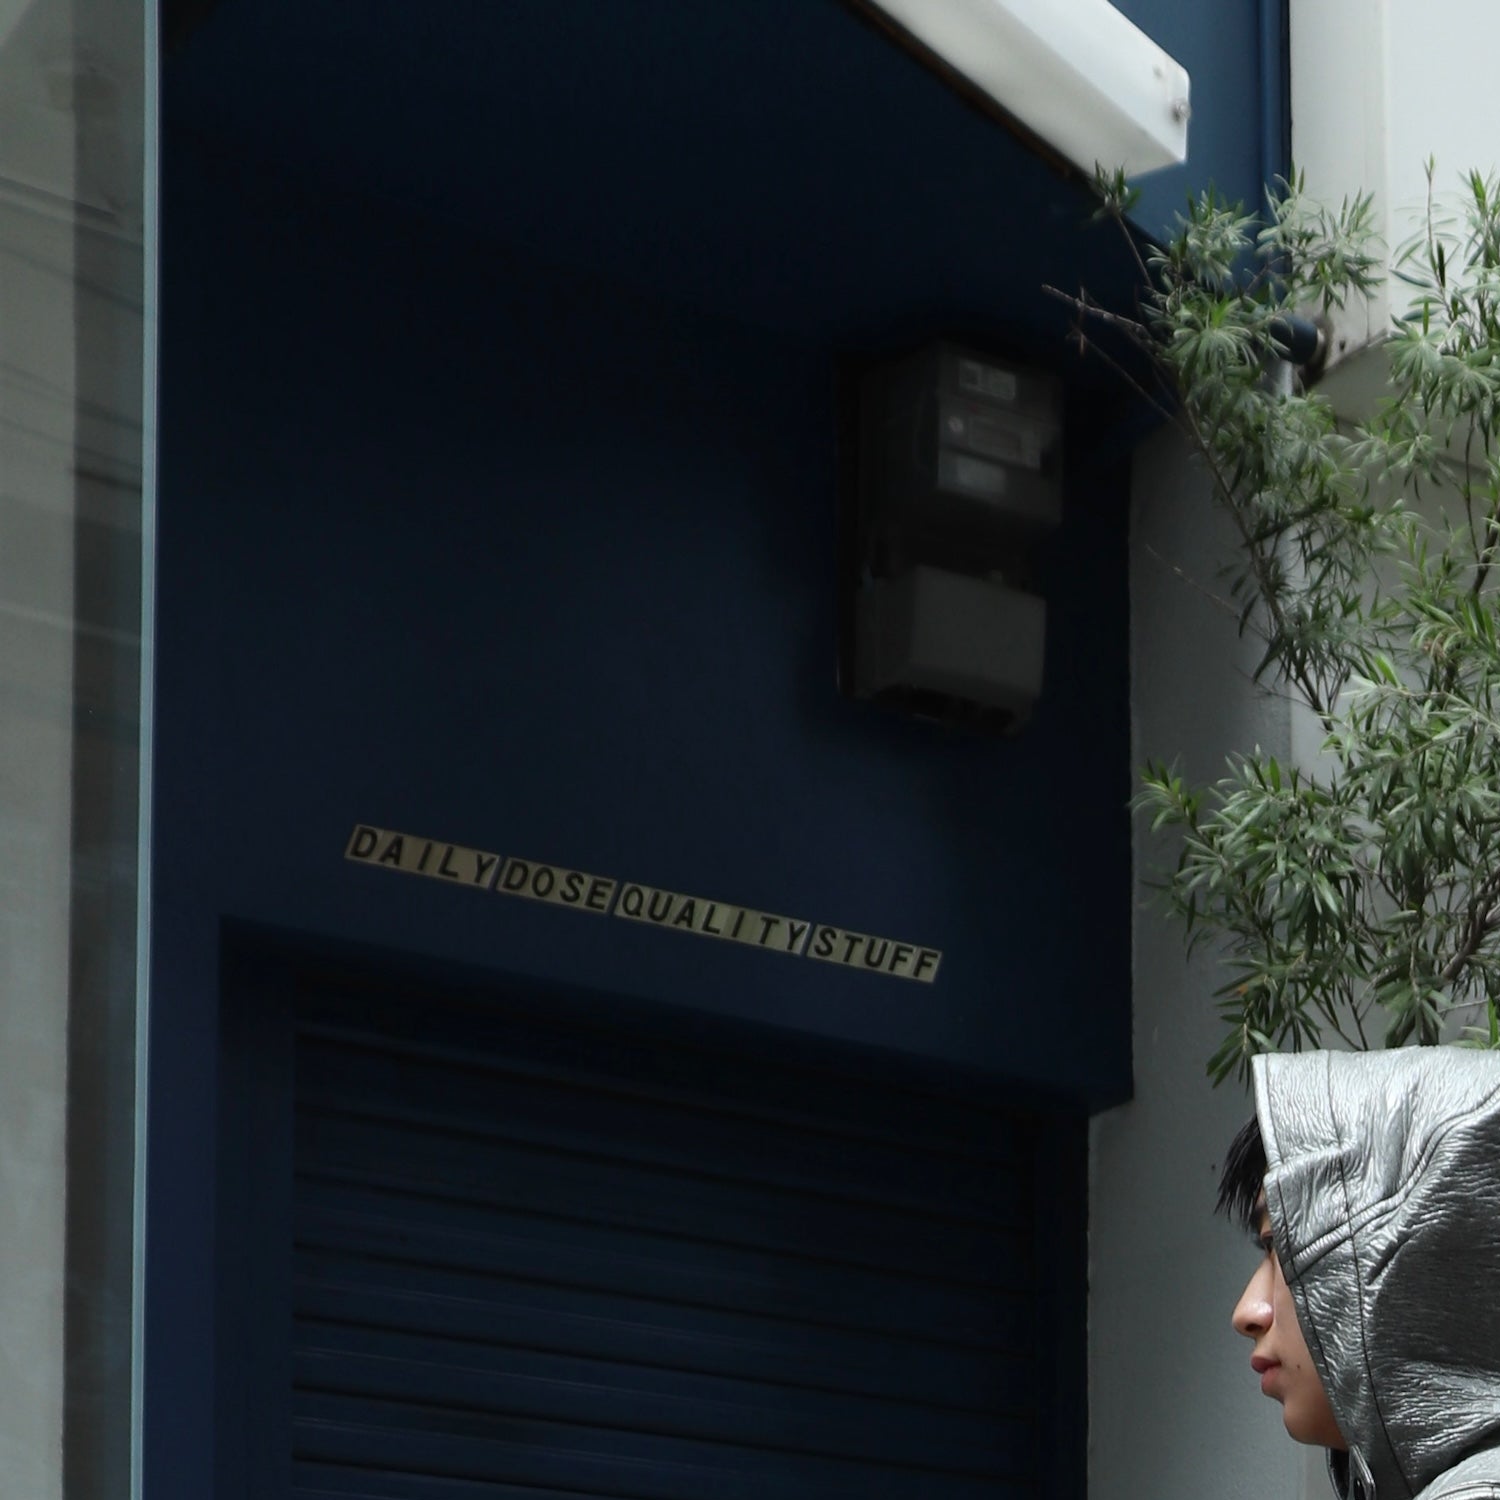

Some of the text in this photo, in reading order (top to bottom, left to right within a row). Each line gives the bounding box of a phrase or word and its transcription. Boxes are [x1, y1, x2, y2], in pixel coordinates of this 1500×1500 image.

[350, 826, 939, 978] DAILY DOSE QUALITY STUFF
